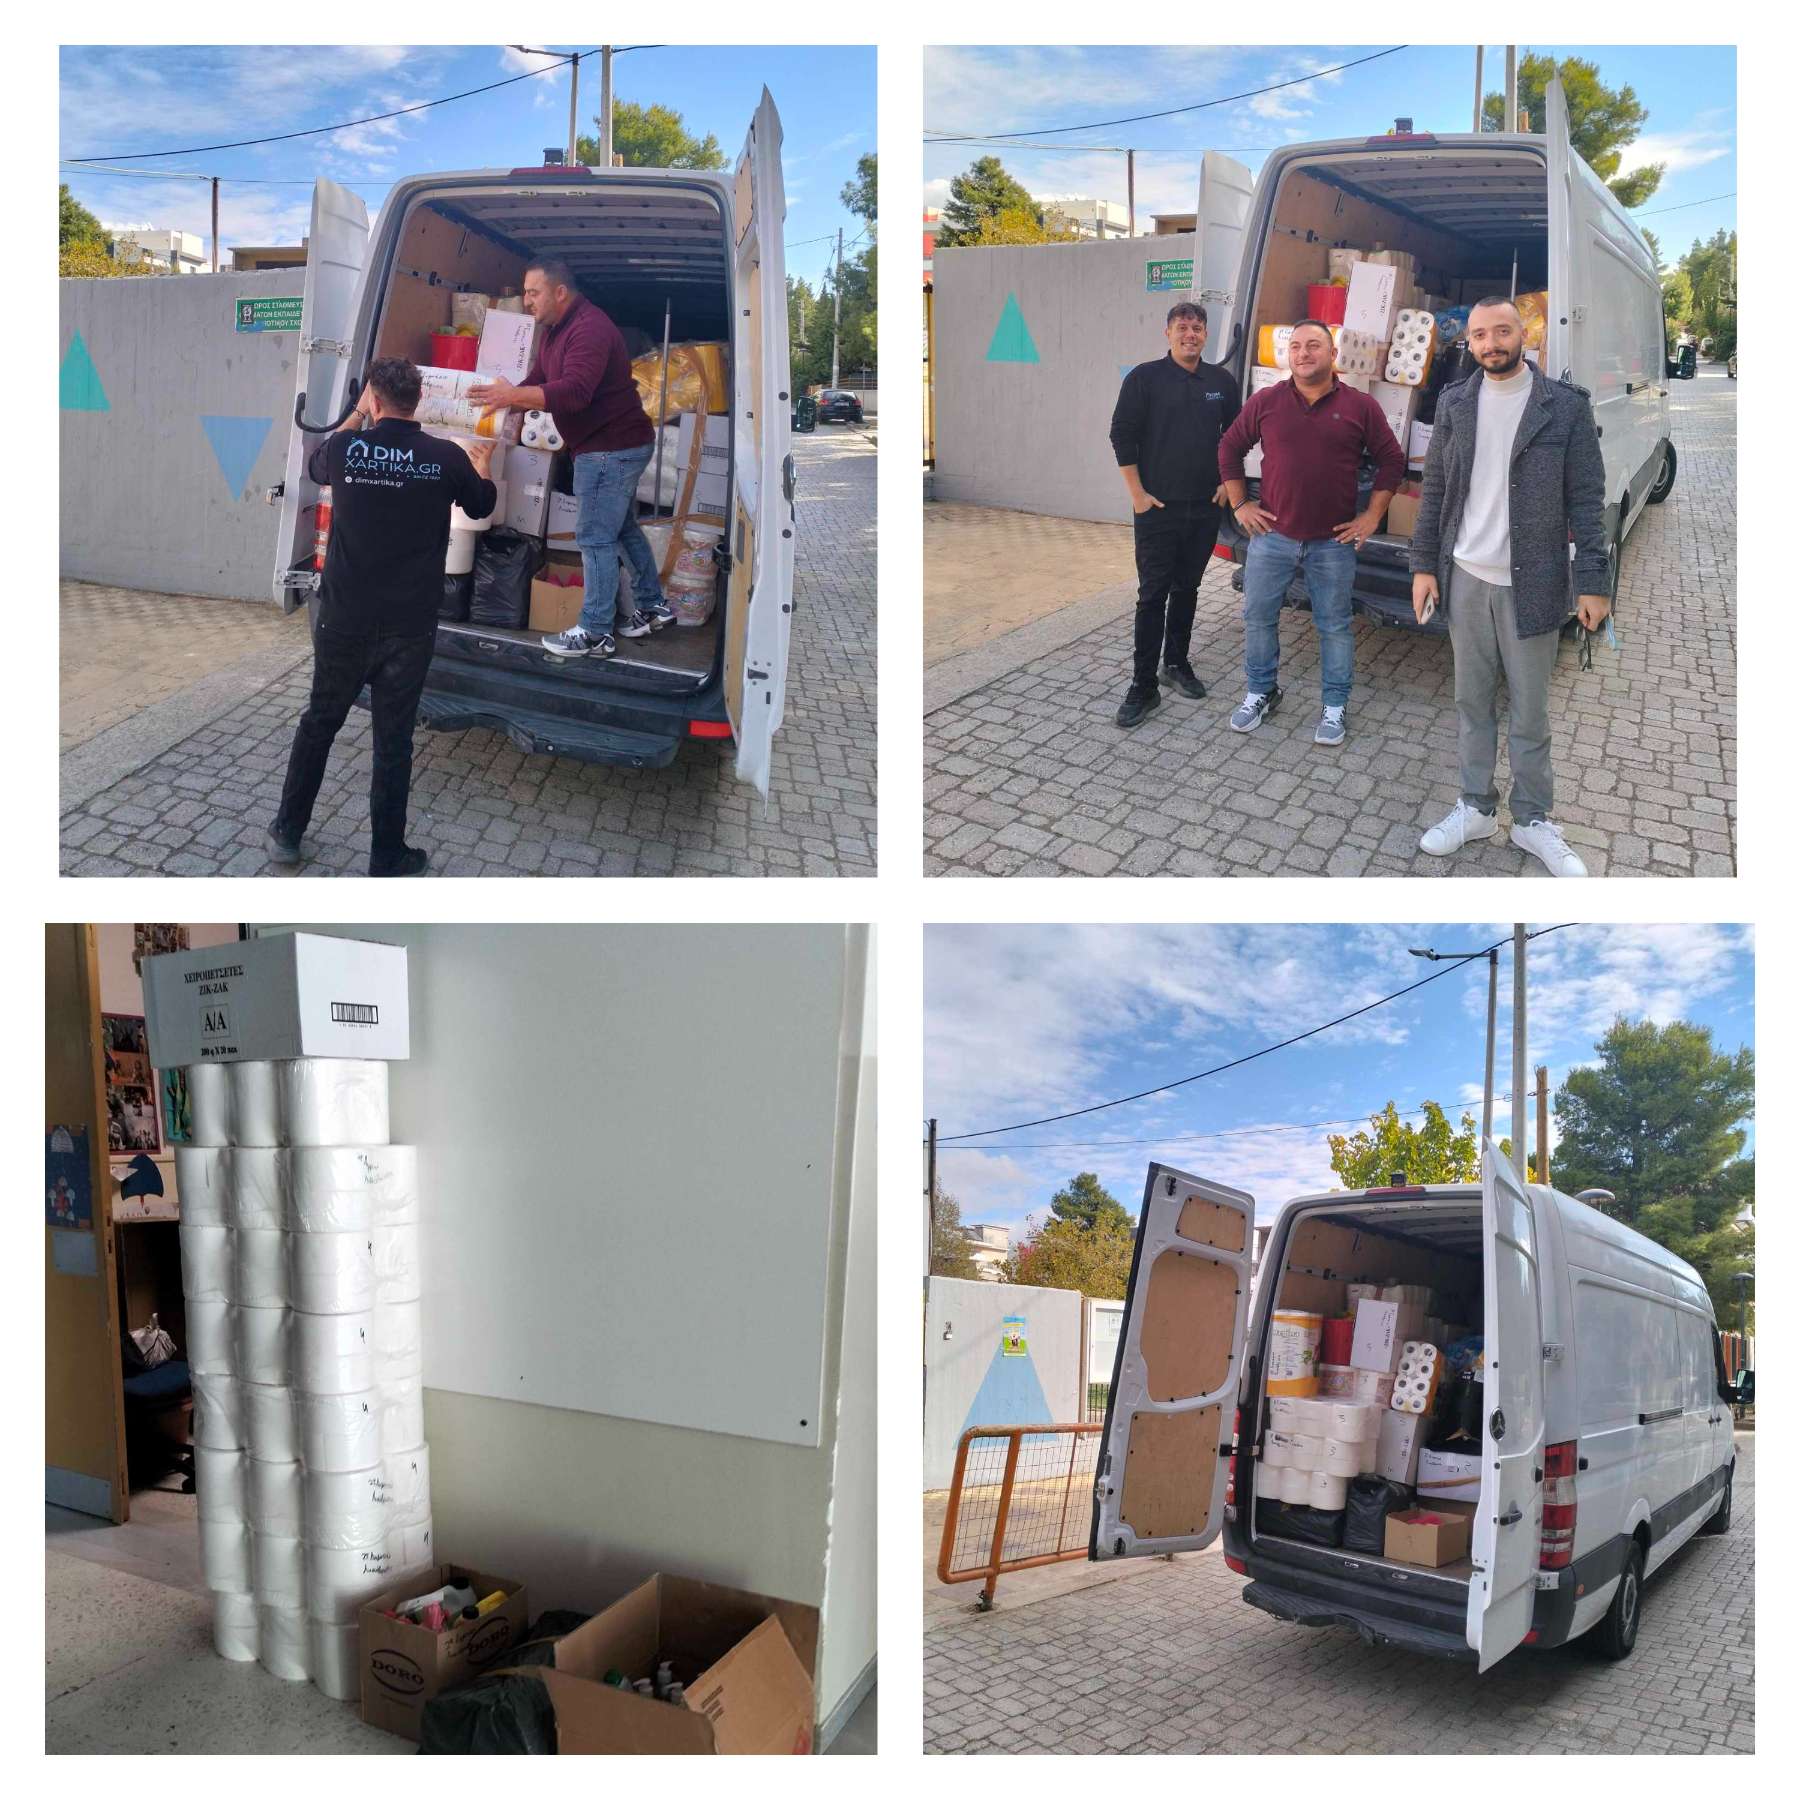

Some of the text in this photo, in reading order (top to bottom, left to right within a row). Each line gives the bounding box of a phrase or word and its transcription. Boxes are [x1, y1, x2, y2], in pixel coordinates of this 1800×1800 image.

[373, 446, 413, 462] DIM
[344, 457, 441, 475] XARTIKA.GR
[355, 477, 404, 488] dimxartika.gr
[184, 965, 244, 984] ΧΕΙΡΟΠΕΤΣΕΤΕΣ
[199, 982, 229, 995] ΖΙΚ-ΖΑΚ
[371, 1658, 425, 1686] DORO
